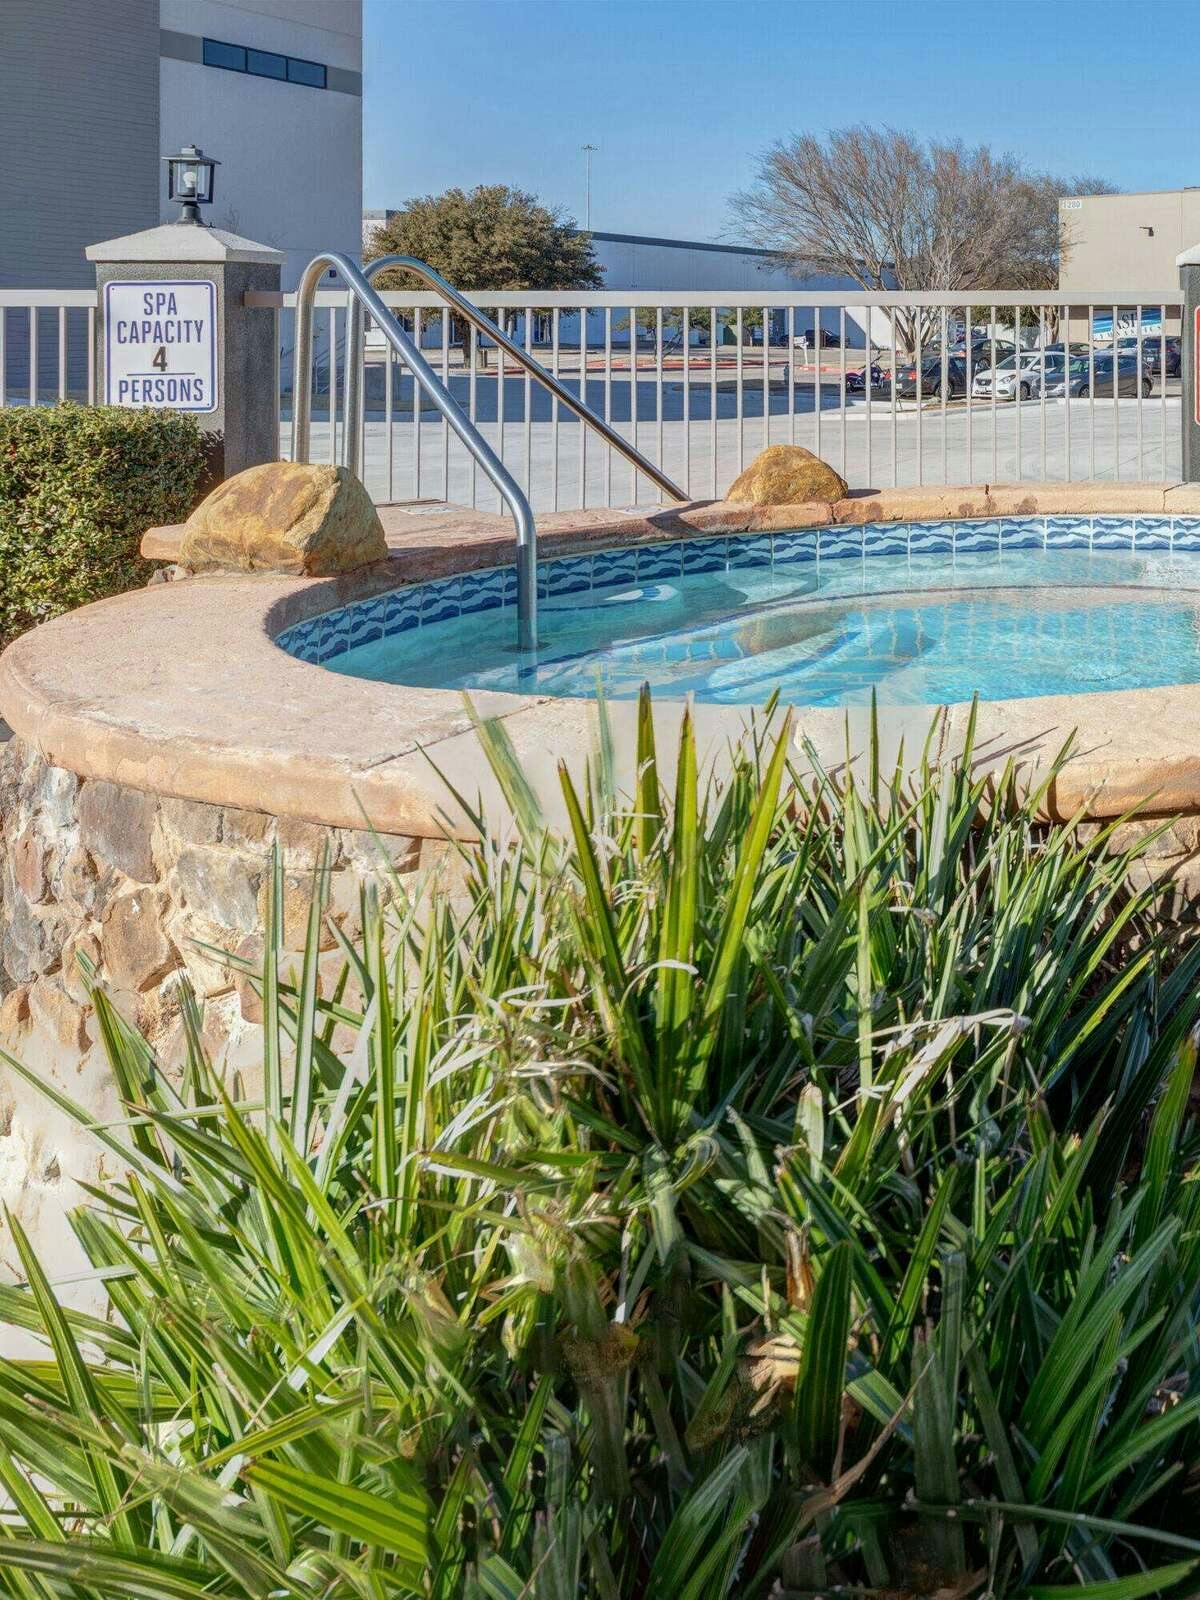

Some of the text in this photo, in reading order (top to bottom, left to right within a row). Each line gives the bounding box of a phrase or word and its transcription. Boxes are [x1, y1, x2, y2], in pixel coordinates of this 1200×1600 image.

[143, 292, 178, 316] SPA
[117, 320, 204, 344] CAPACITY
[152, 346, 168, 372] 4
[118, 378, 204, 403] PERSONS
